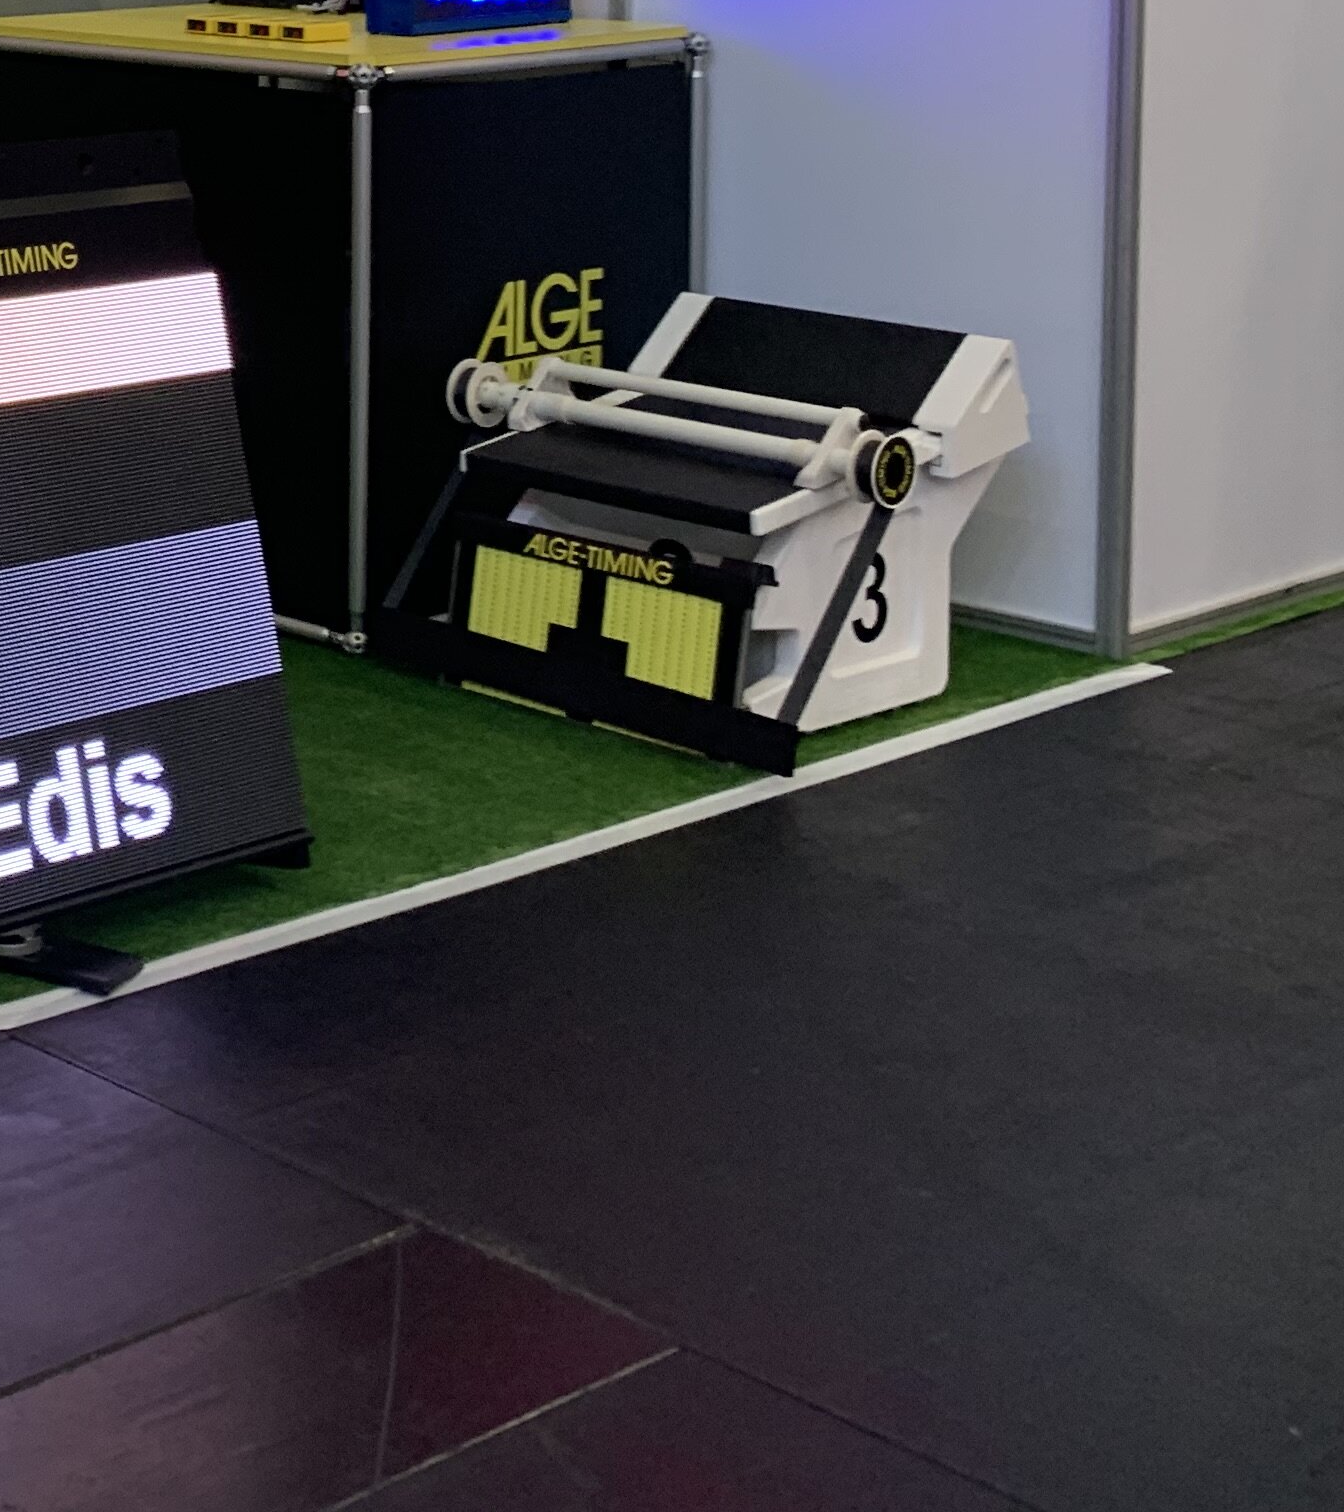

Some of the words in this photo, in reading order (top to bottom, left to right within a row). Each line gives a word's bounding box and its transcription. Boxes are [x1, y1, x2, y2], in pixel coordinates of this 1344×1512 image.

[476, 267, 604, 363] ALGE
[523, 533, 674, 585] ALGE-TIMING
[851, 553, 888, 644] 3
